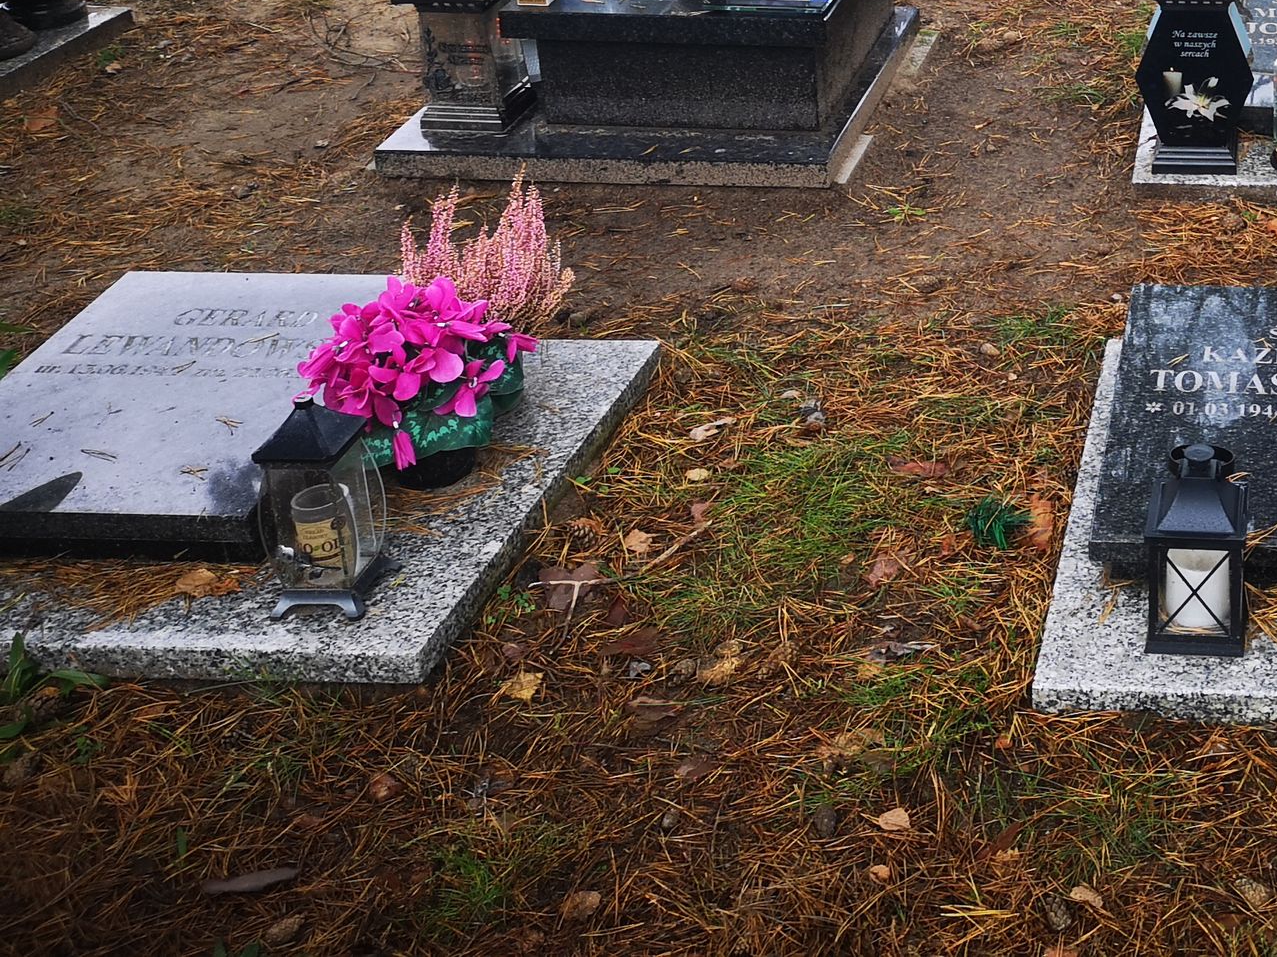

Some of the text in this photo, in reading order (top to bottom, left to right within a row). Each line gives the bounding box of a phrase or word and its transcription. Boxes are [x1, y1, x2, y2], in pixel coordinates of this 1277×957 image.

[1172, 30, 1218, 39] Na zawsze
[1184, 40, 1217, 50] naszych
[1180, 49, 1210, 58] sercach
[173, 306, 319, 328] GERARD
[61, 333, 322, 360] LEWANDOWS
